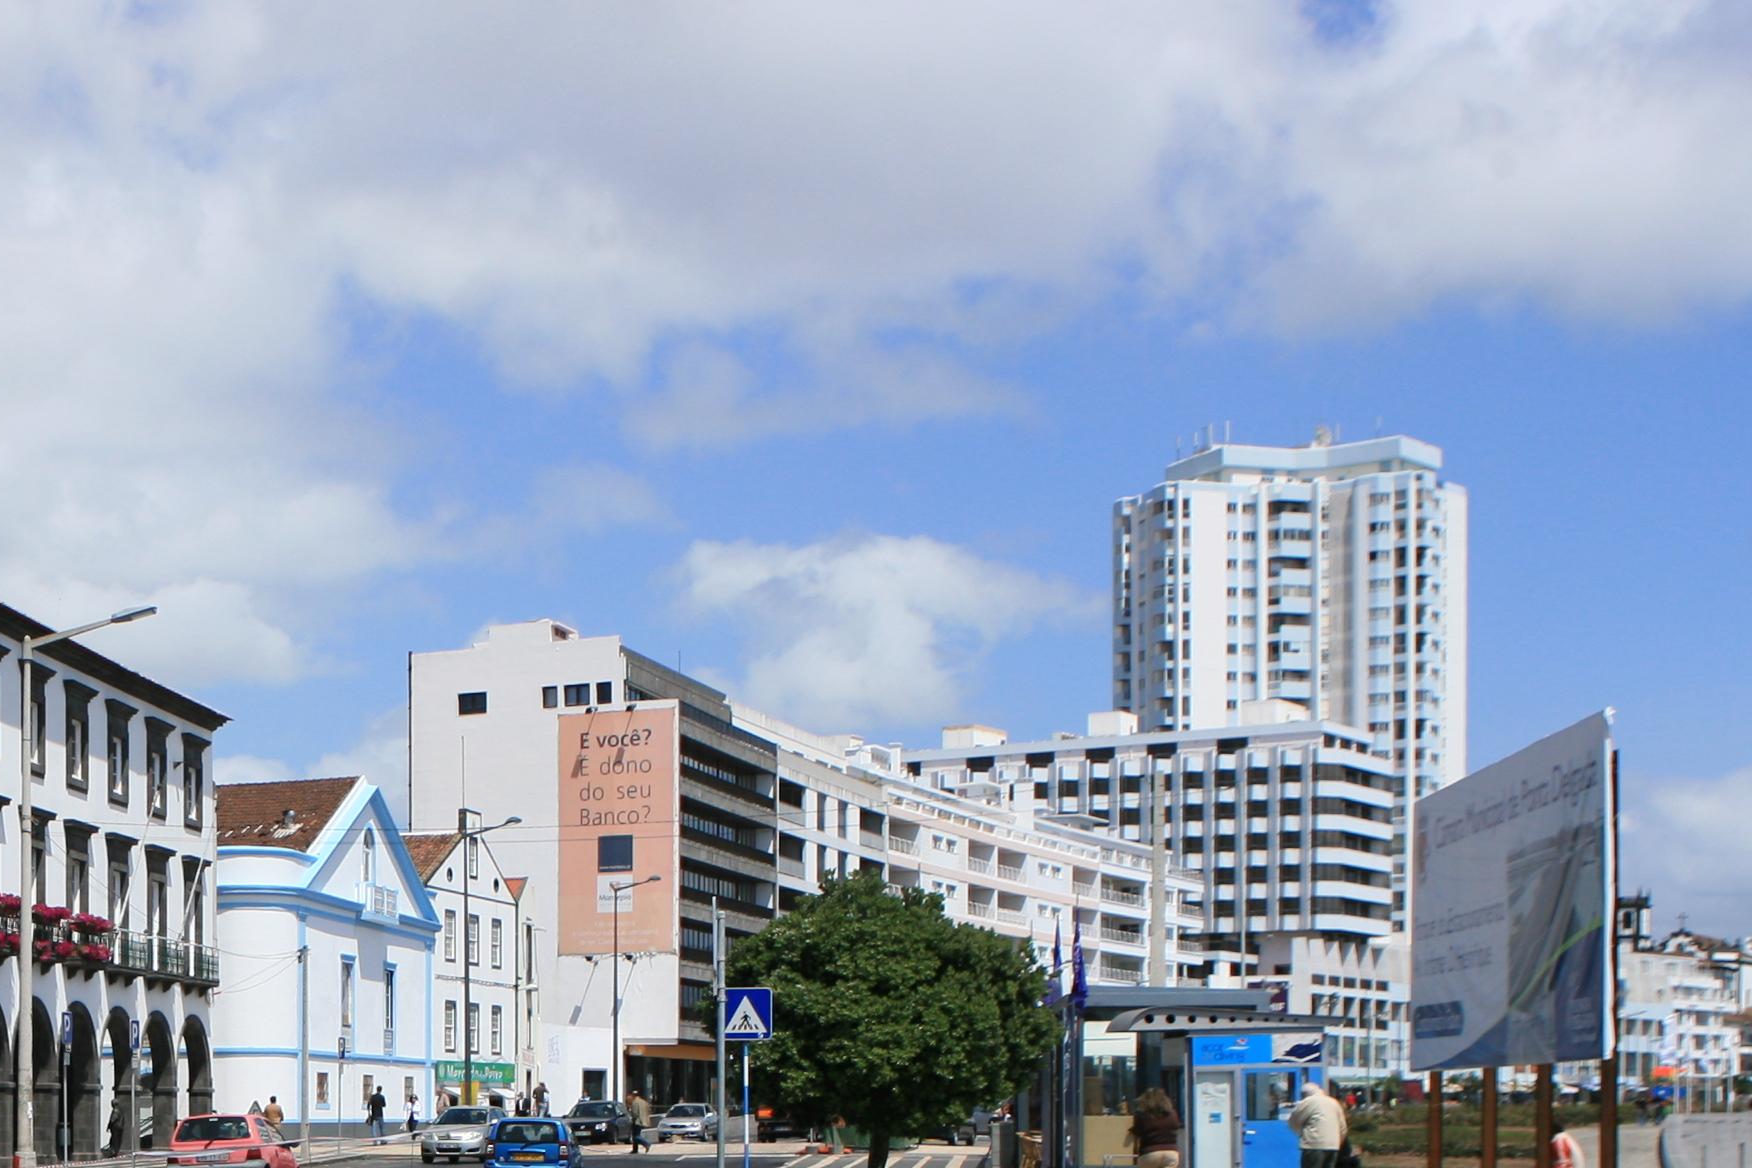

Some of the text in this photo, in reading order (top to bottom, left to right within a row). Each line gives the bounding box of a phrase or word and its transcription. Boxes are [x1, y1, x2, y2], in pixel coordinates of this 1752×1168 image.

[596, 728, 652, 748] você?
[600, 756, 652, 775] dono
[579, 781, 651, 801] do seu
[580, 805, 651, 826] Banco?
